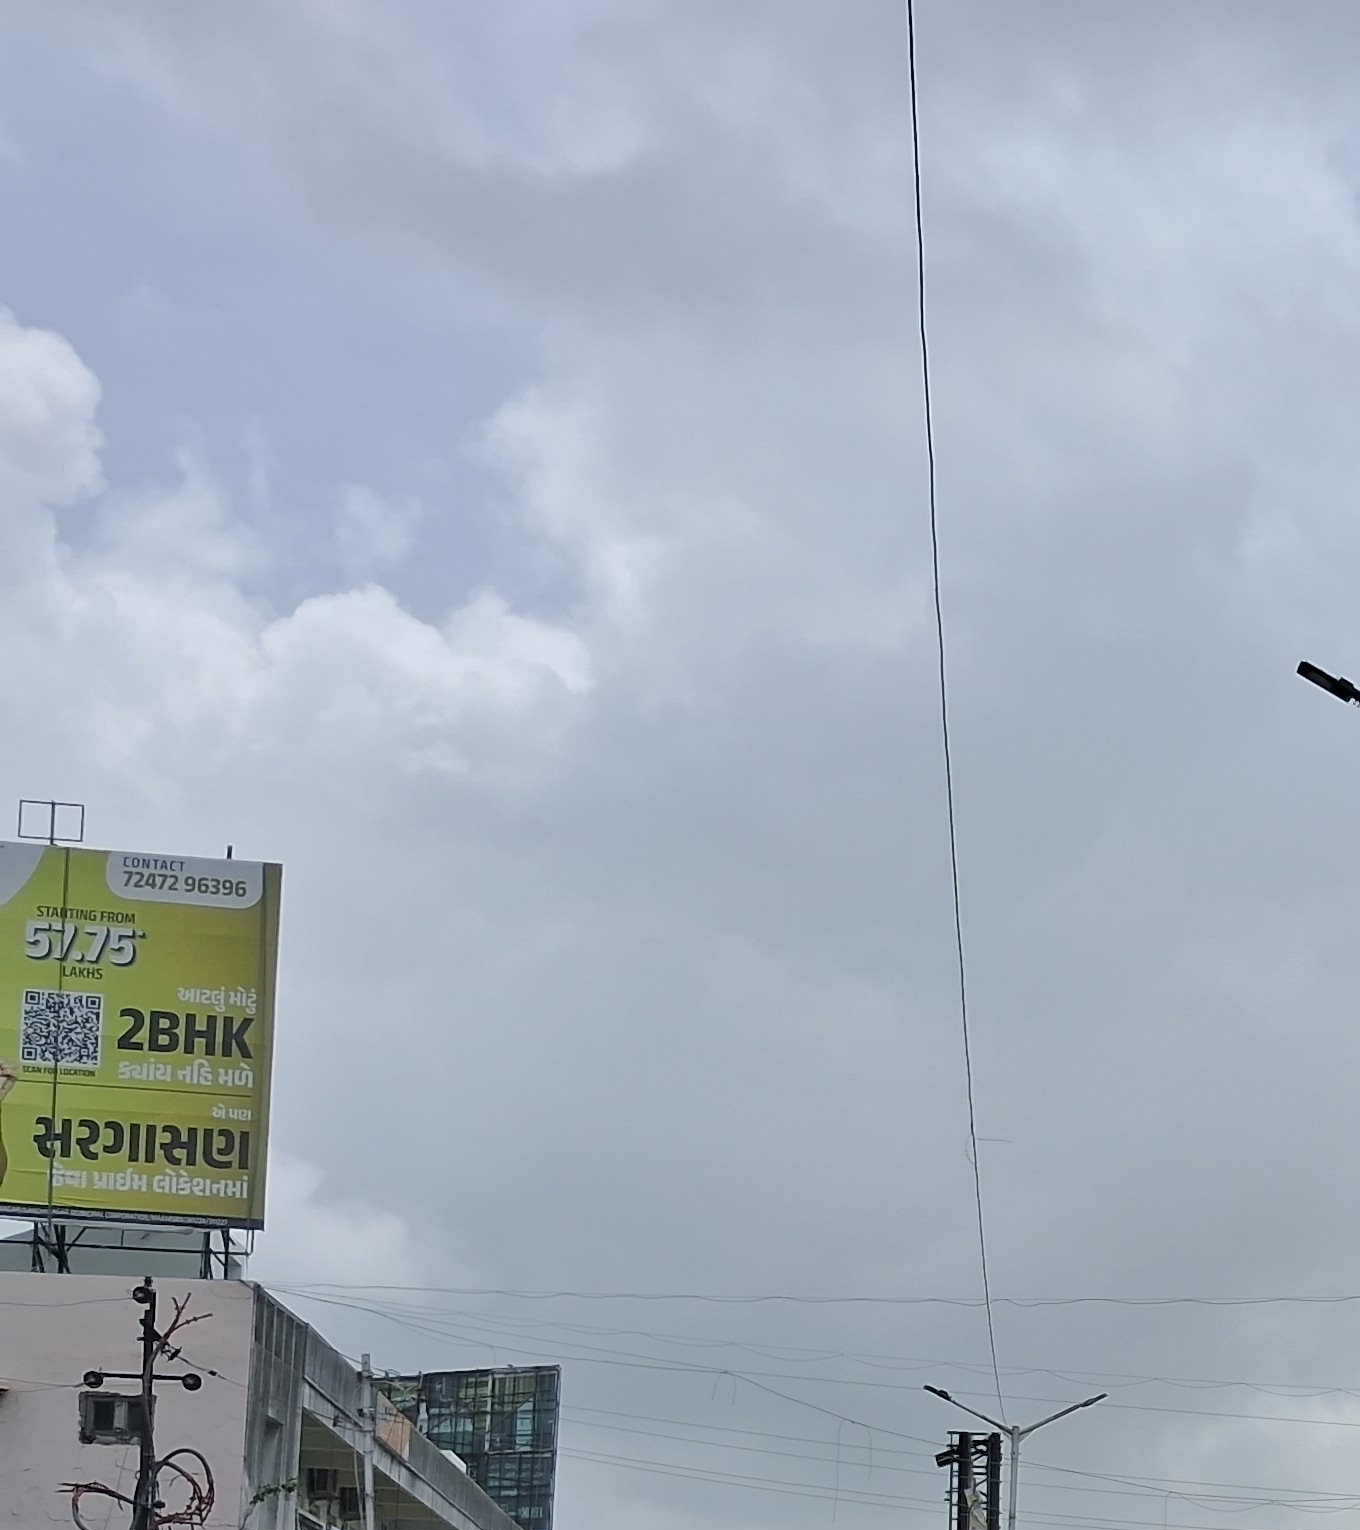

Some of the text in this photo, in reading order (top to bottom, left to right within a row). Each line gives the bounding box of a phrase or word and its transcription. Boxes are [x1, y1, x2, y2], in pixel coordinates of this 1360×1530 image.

[123, 856, 187, 872] CONTACT
[123, 871, 247, 897] 72472 96396
[100, 911, 136, 924] FROM
[62, 965, 104, 981] LAKHS
[117, 1008, 254, 1060] 2BHK
[33, 1115, 249, 1171] સરગાસણ
